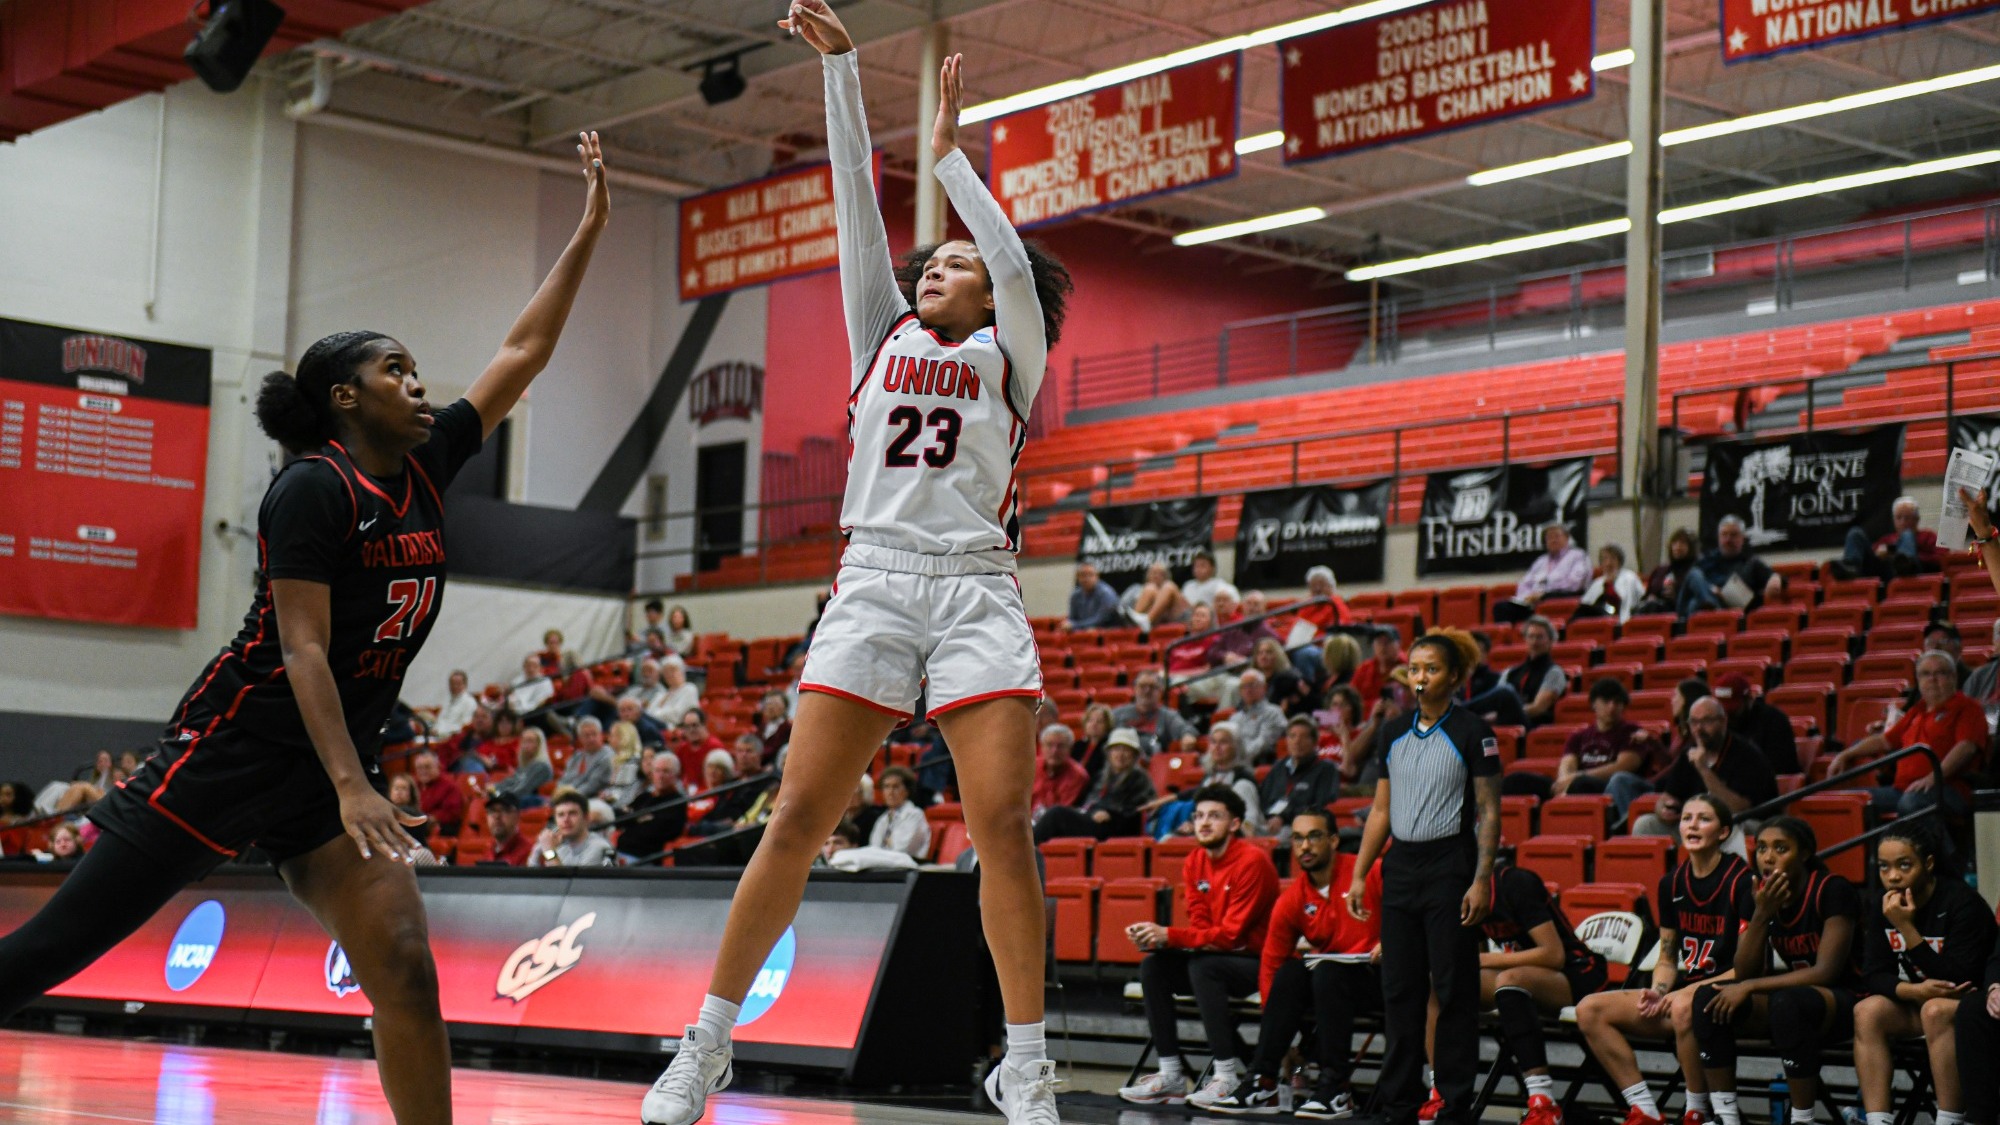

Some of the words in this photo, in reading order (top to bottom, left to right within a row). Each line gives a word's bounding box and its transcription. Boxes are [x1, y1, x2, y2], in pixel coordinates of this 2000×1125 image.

[1378, 10, 1435, 48] 2006
[1438, 0, 1488, 35] NAIA
[1766, 0, 1899, 48] NATIONAL
[1379, 30, 1475, 78] DIVISION
[1480, 27, 1488, 54] I
[1411, 39, 1556, 98] BASKETBALL
[1122, 74, 1172, 112] NAIA
[1318, 102, 1424, 148] NATIONAL
[1437, 71, 1551, 122] CHAMPION
[1054, 113, 1141, 158] DIVISION
[1092, 116, 1222, 176] BASKETBALL
[1012, 178, 1101, 226] NATIONAL
[1106, 150, 1209, 201] CHAMPION
[695, 217, 776, 260] BASKETBALL
[62, 334, 147, 385] UNION
[883, 355, 980, 401] UNION
[885, 404, 963, 469] 23
[1793, 459, 1866, 484] BONE
[1789, 488, 1864, 520] JOINT
[373, 576, 437, 643] 21
[170, 943, 215, 968] NCAA
[1683, 936, 1716, 974] 26
